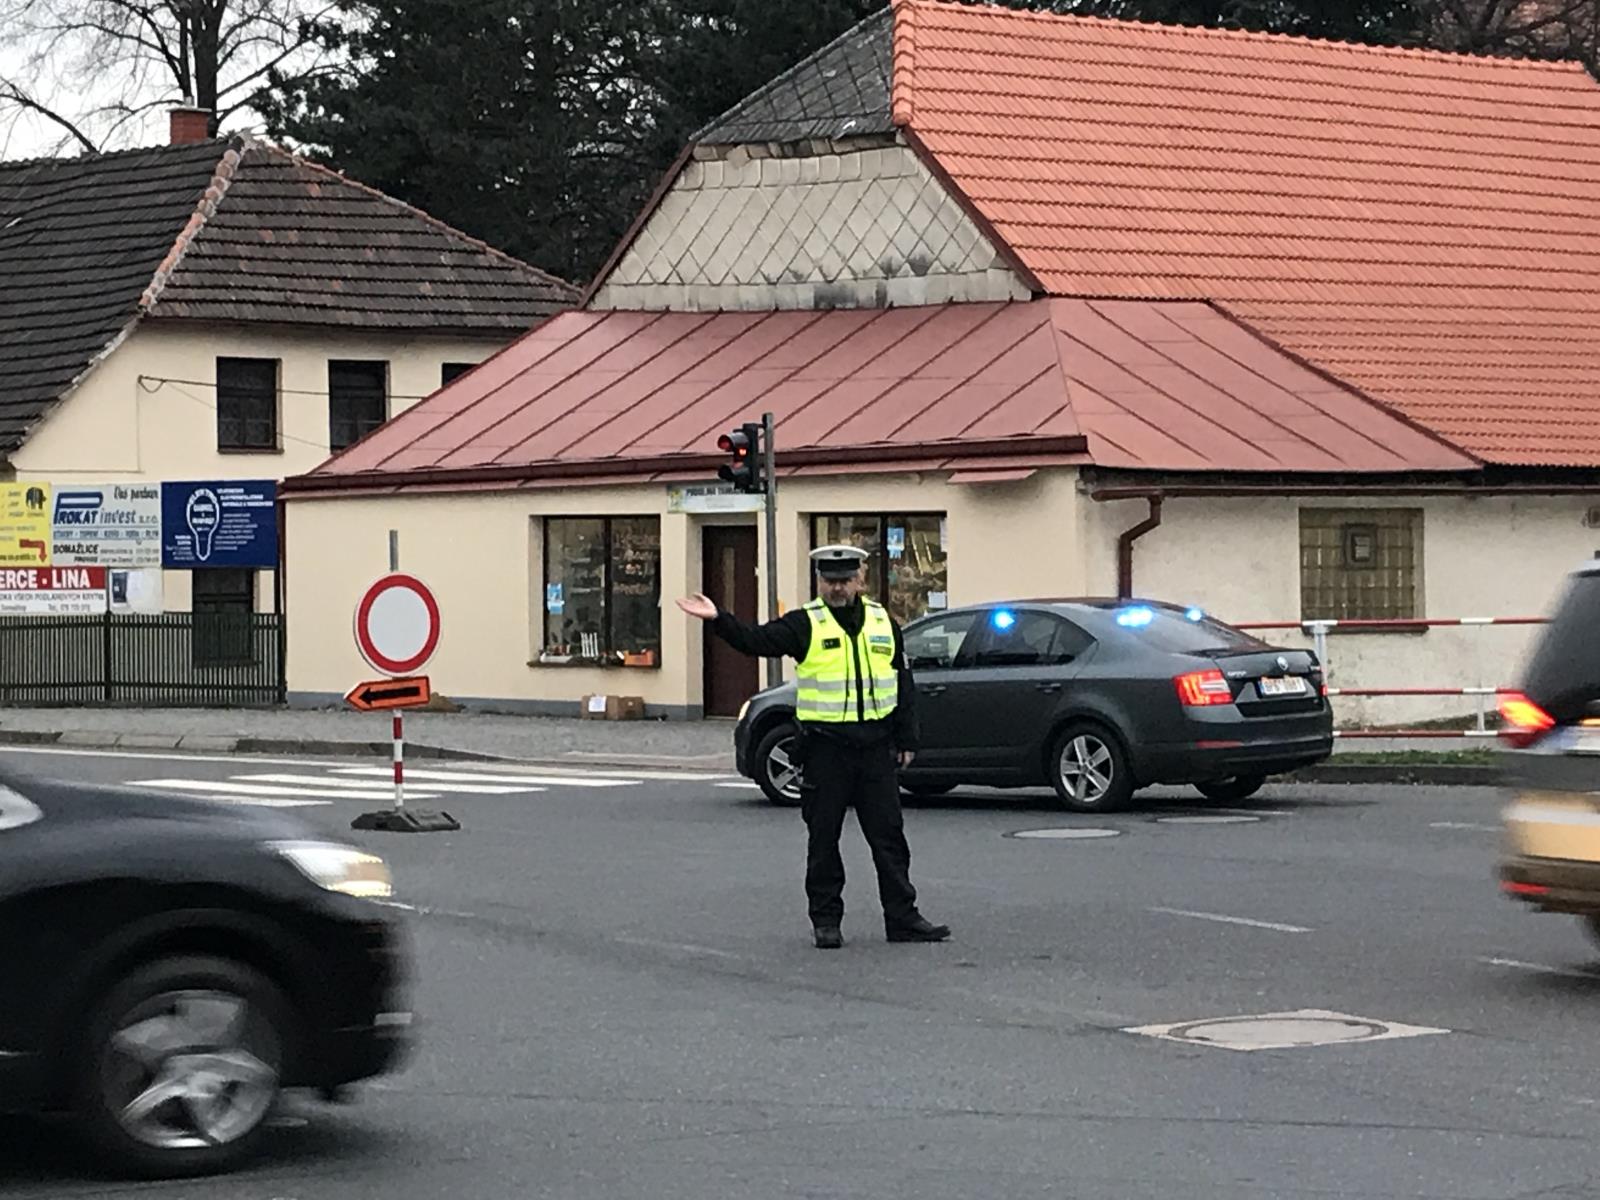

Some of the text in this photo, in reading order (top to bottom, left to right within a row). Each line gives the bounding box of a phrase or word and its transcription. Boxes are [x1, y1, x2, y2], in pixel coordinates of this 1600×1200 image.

[101, 508, 136, 524] invest
[53, 542, 99, 554] DOMAŽLICE
[51, 569, 91, 589] LINA
